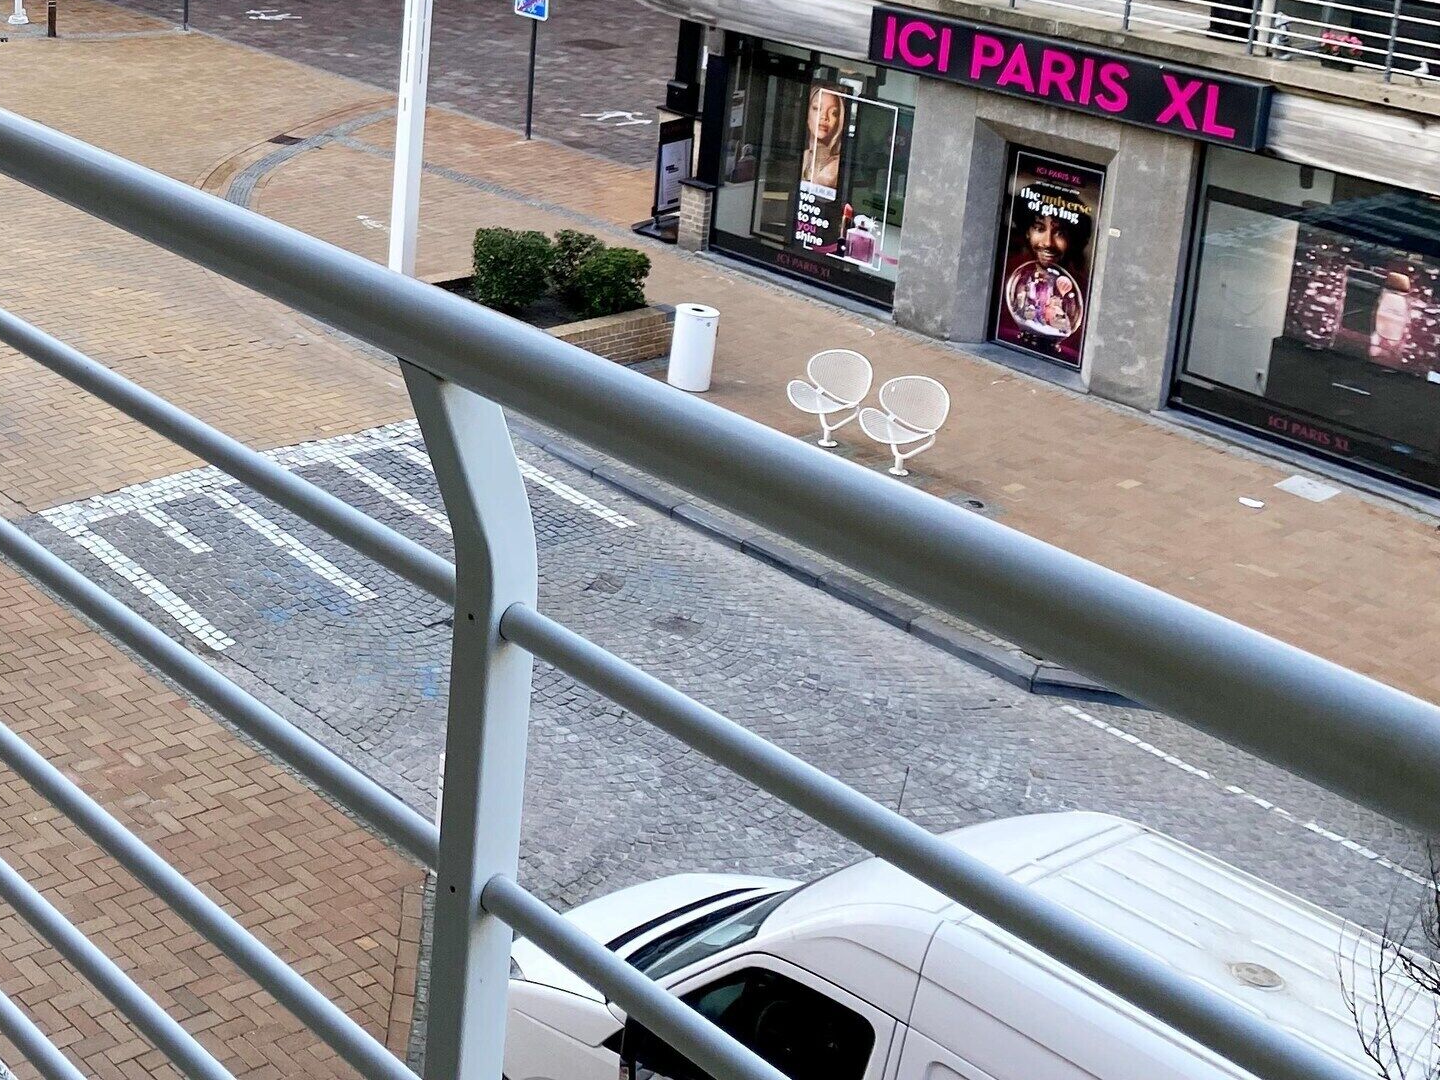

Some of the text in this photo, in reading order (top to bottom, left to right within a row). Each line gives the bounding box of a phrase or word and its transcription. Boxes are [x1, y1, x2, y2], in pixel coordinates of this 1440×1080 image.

[883, 16, 1236, 140] ICI PARIS XL
[1048, 170, 1070, 180] PARIS
[799, 191, 815, 203] we
[1020, 187, 1041, 200] the
[1041, 194, 1092, 214] universe
[798, 201, 821, 215] love
[1027, 200, 1079, 225] of giving
[796, 221, 817, 233] you
[797, 211, 829, 229] to see
[795, 230, 823, 246] shine
[1292, 423, 1330, 445] PARIS
